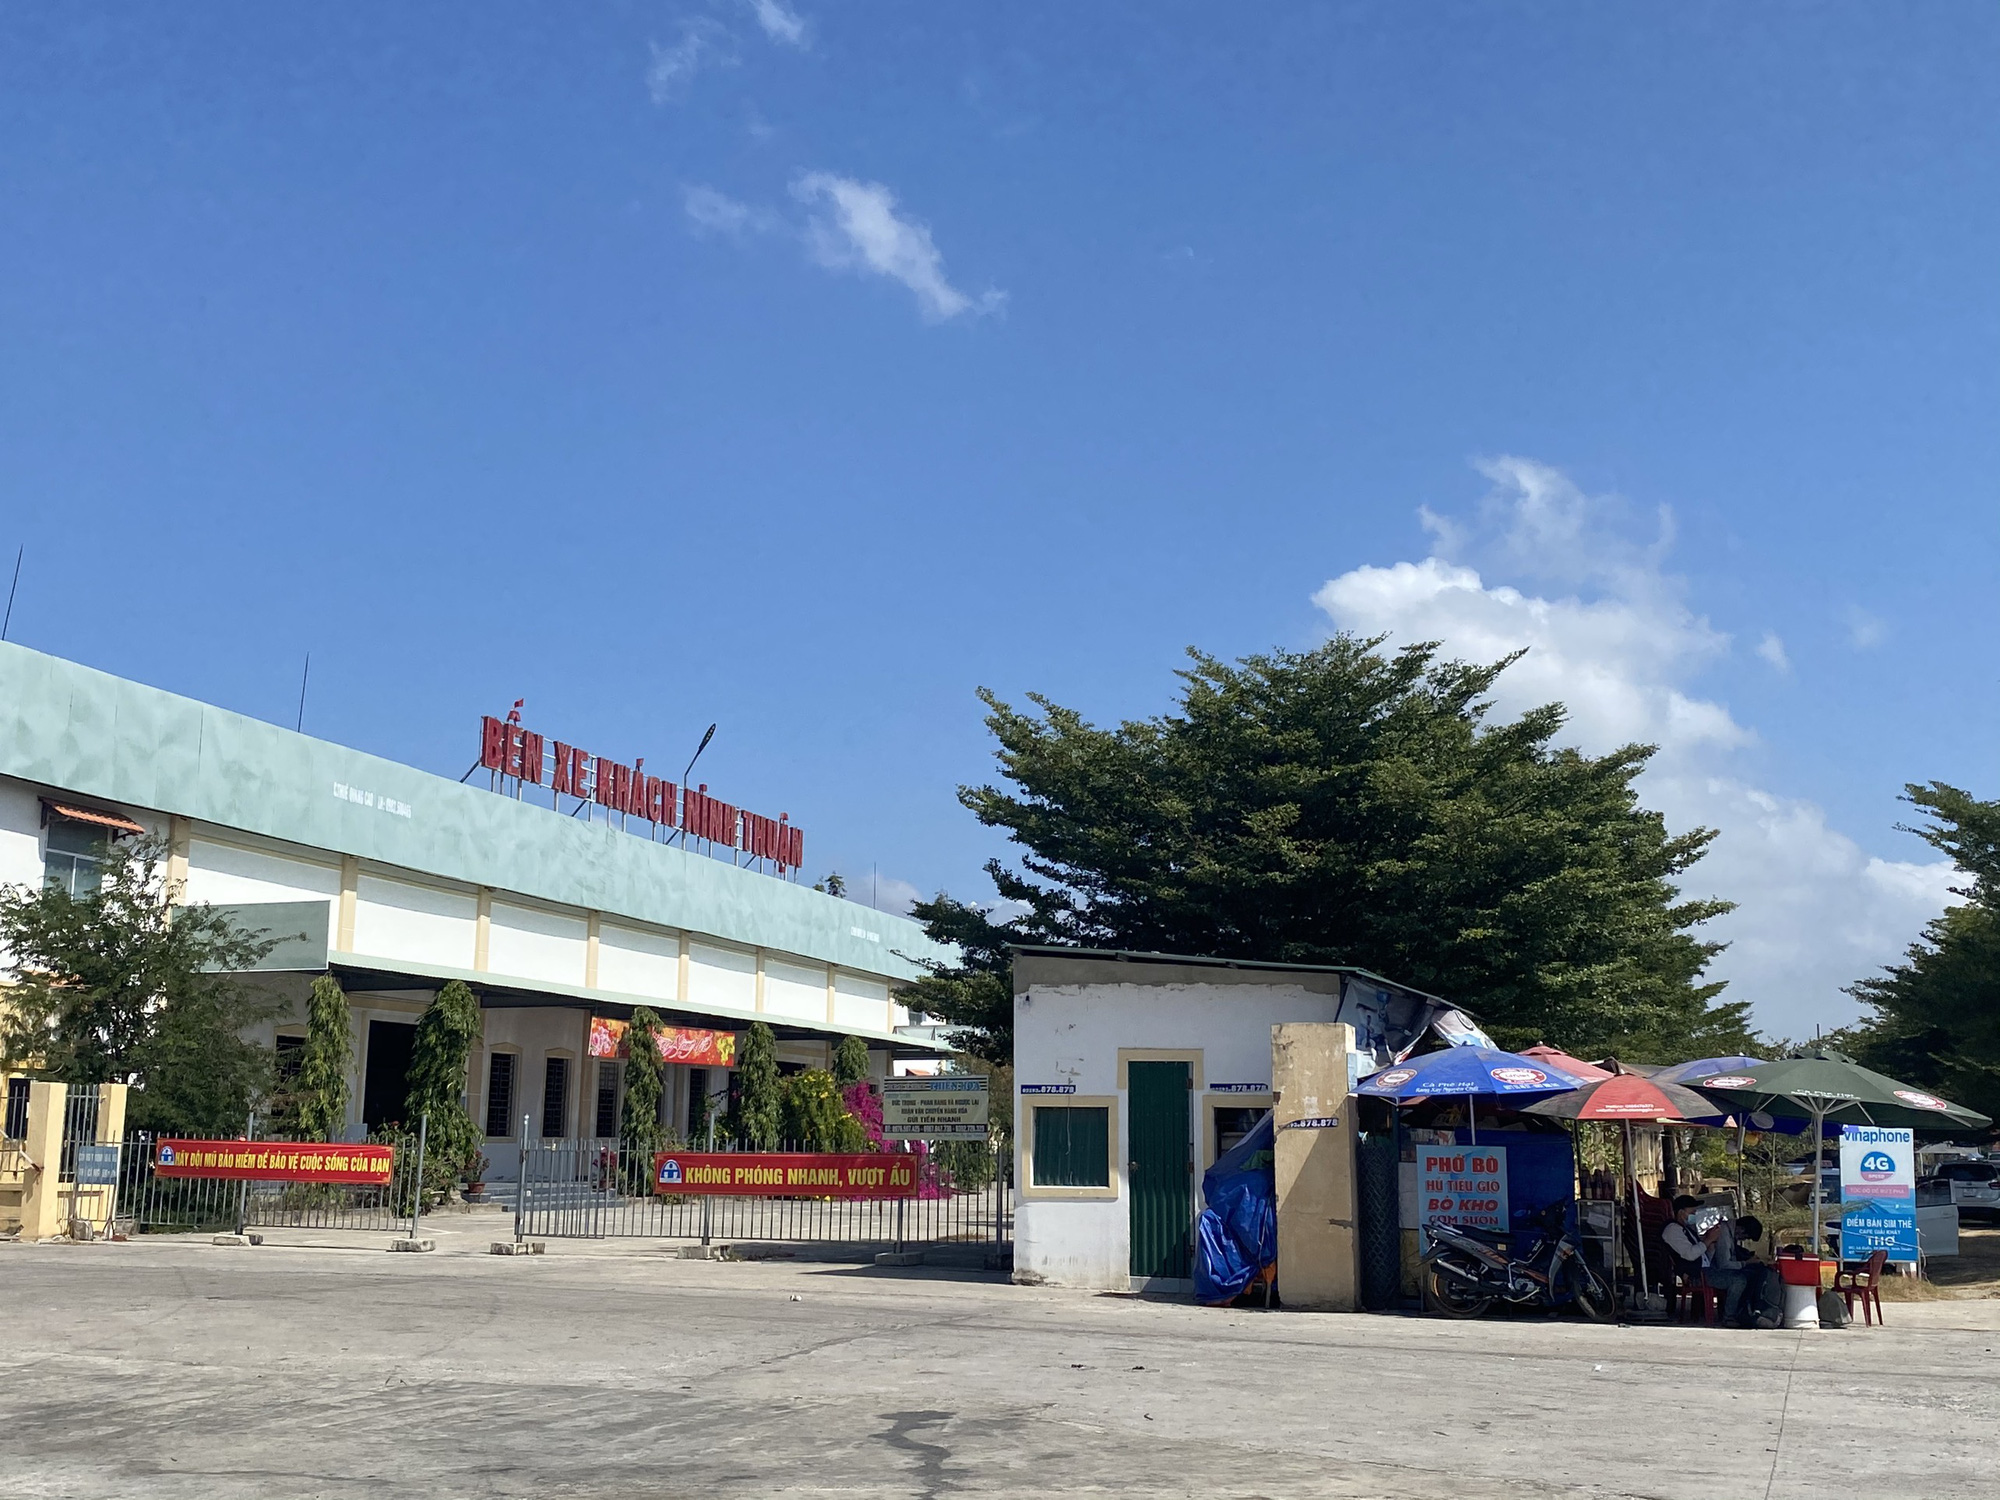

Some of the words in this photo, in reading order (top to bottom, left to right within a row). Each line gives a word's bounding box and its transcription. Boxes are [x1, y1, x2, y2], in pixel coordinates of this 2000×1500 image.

[481, 698, 544, 785] BẾN
[552, 740, 588, 798] XE
[595, 757, 677, 828] KHÁCH
[741, 809, 803, 873] THUẬN
[1844, 1129, 1910, 1144] vinaphone
[175, 1150, 189, 1166] HÃY
[190, 1150, 203, 1169] ĐỘI
[204, 1151, 217, 1167] MŨ
[218, 1149, 234, 1168] BẢO
[235, 1148, 256, 1169] HIỂM
[257, 1149, 270, 1169] ĐỂ
[270, 1150, 286, 1169] BẢO
[288, 1152, 298, 1173] VỆ
[300, 1153, 323, 1173] CUỘC
[325, 1151, 348, 1171] SỐNG
[351, 1153, 368, 1172] CỦA
[370, 1158, 390, 1175] BẠN
[1426, 1153, 1465, 1172] PHỞ
[1472, 1155, 1499, 1173] BÒ
[1864, 1156, 1889, 1171] 4G
[685, 1164, 731, 1184] KHÔNG
[735, 1165, 783, 1185] PHÓNG
[787, 1168, 843, 1187] NHANH,
[848, 1166, 886, 1189] VƯỢT
[889, 1161, 910, 1185] ẨU
[1459, 1199, 1499, 1211] KHO
[1846, 1213, 1865, 1227] ĐIỂM
[1866, 1216, 1882, 1227] BÁN
[1883, 1219, 1896, 1228] SIM
[1898, 1216, 1912, 1228] THẺ
[1867, 1235, 1895, 1246] THƠ
